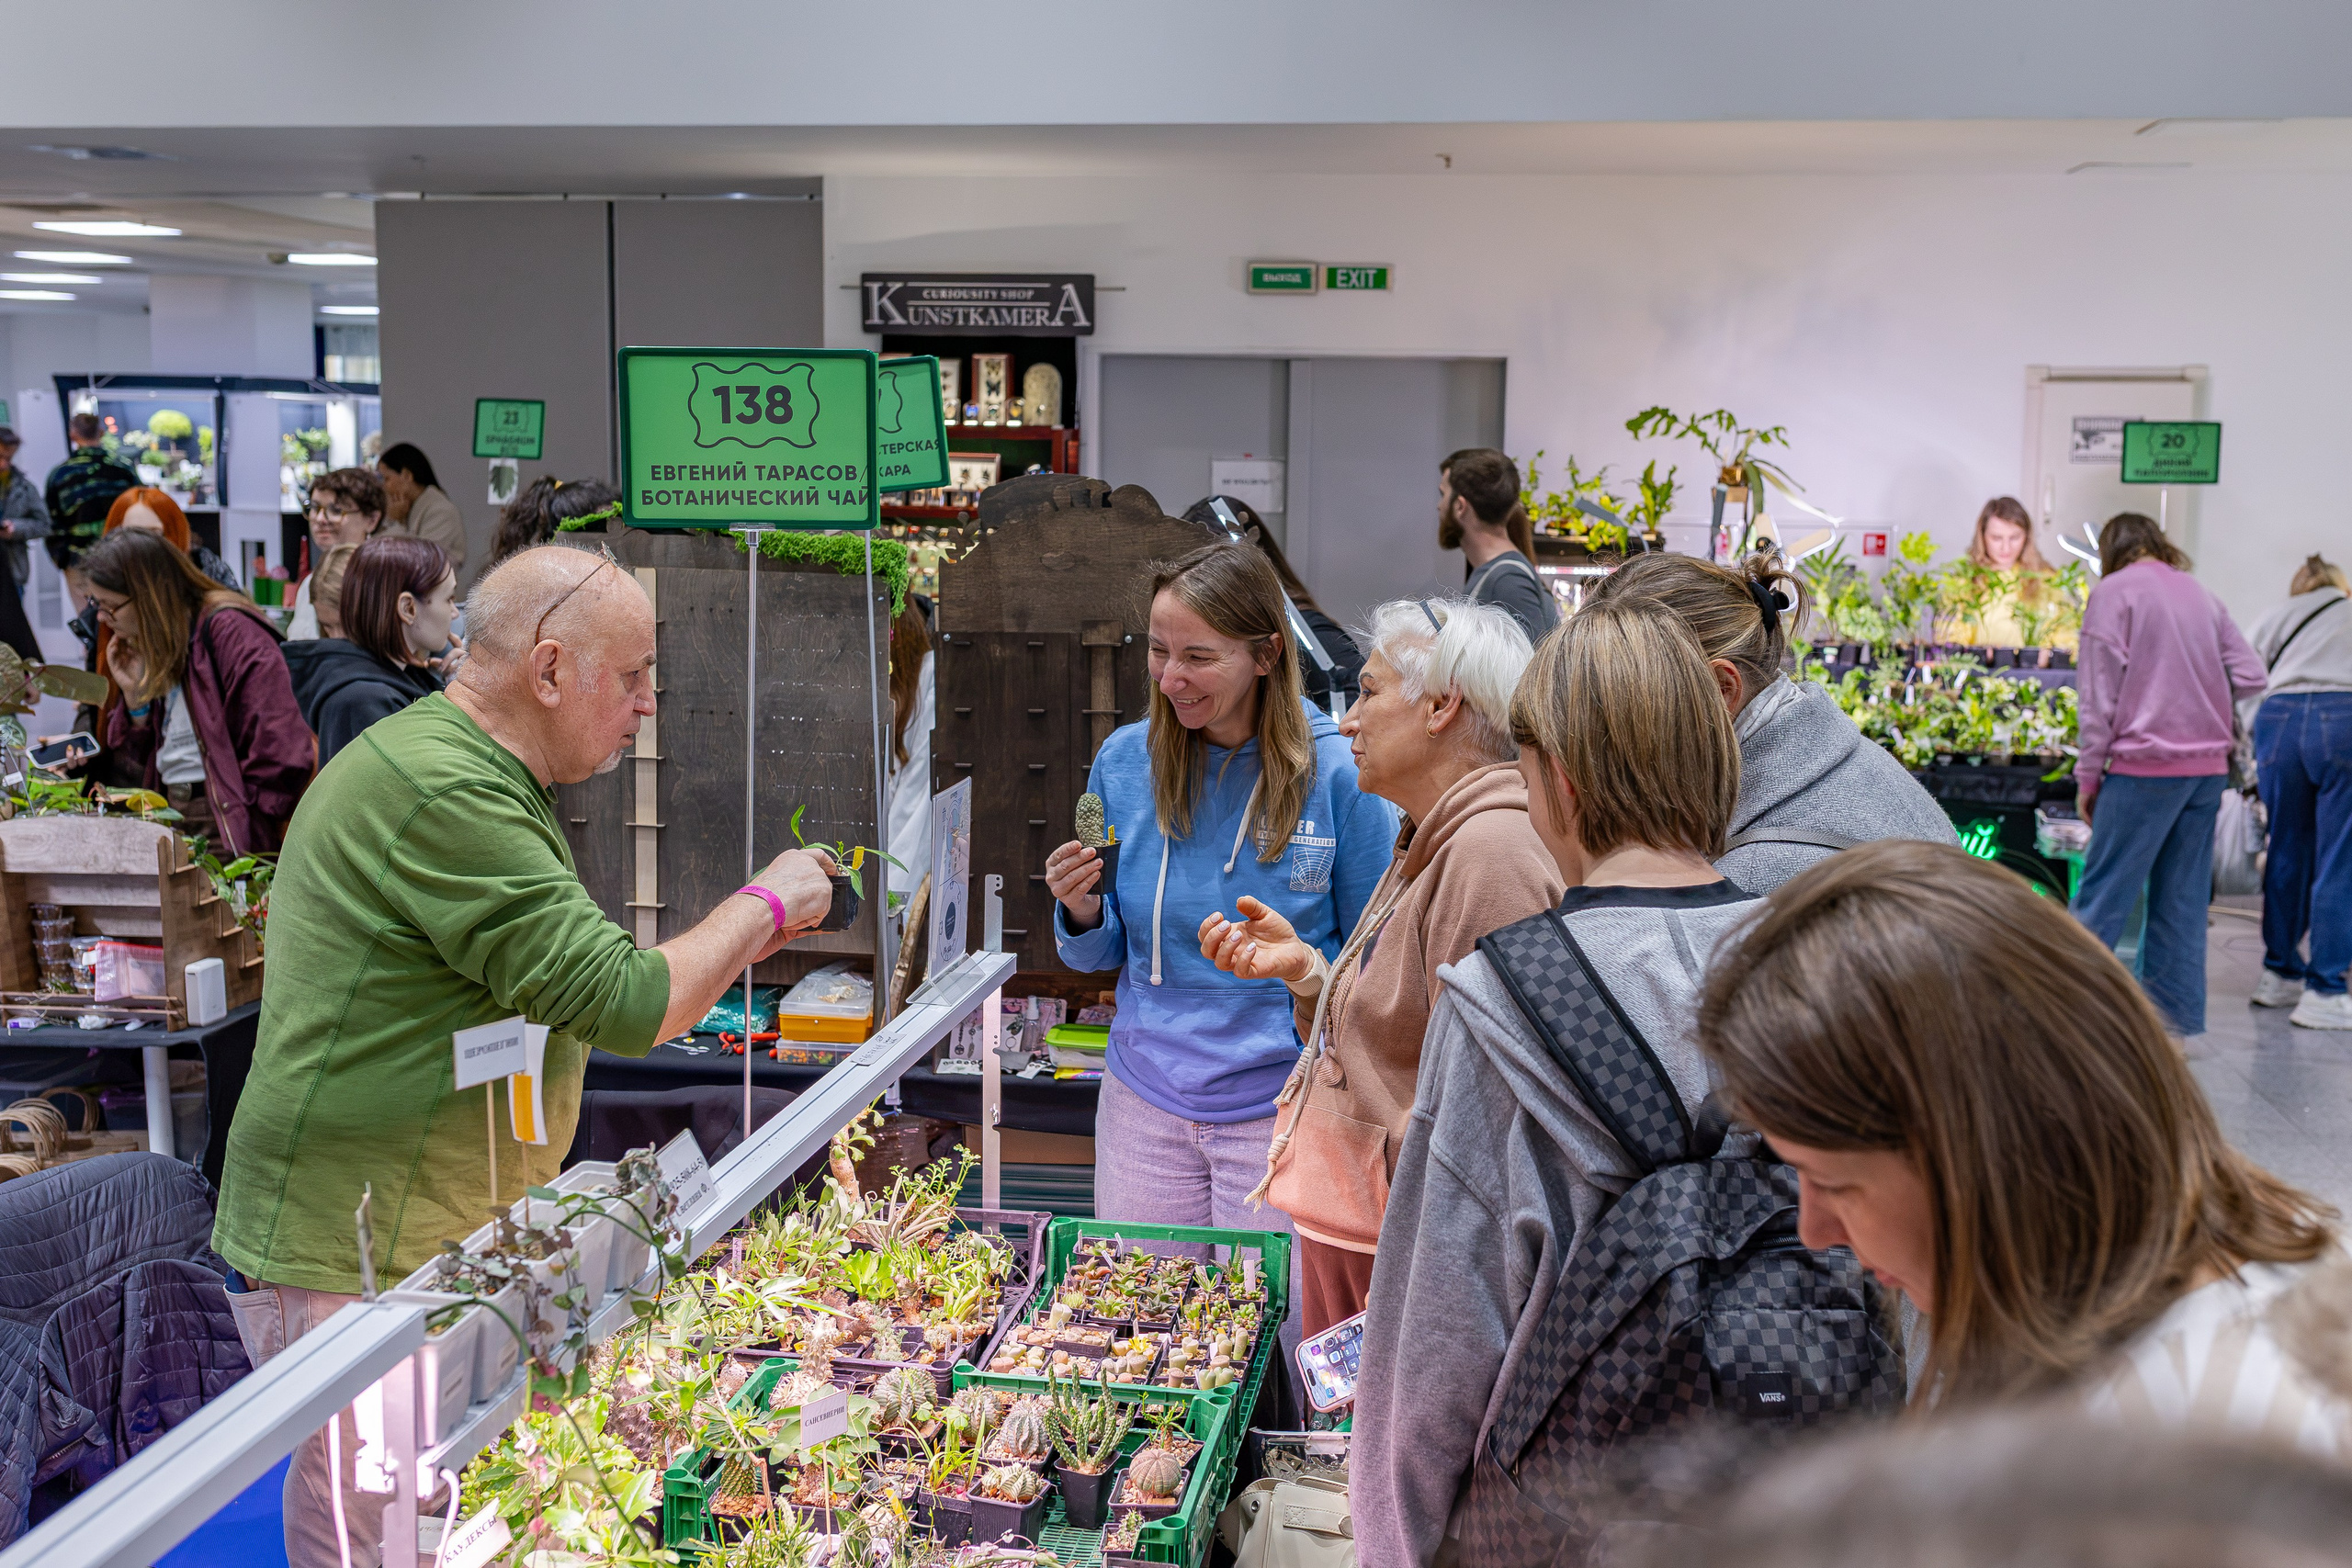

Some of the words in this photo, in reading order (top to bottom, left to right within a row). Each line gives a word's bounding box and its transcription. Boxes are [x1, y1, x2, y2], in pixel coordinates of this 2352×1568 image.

[1336, 269, 1377, 288] EXIT
[922, 288, 998, 300] CURIOUSITY
[1000, 288, 1035, 300] SHOP
[864, 282, 1091, 327] KUNSTKAMERA
[712, 385, 794, 425] 138
[503, 411, 519, 424] 23
[879, 439, 939, 456] ТЕРСКАЯ
[2161, 433, 2187, 449] 20
[650, 461, 746, 481] ЕВГЕНИЙ
[641, 486, 820, 506] БОТАНИЧЕСКИЙ
[827, 485, 868, 506] ЧАЙ
[1294, 836, 1335, 845] GENERATION
[1758, 1392, 1781, 1403] VANS
[445, 1514, 497, 1563] КАУДЕКСЫ
